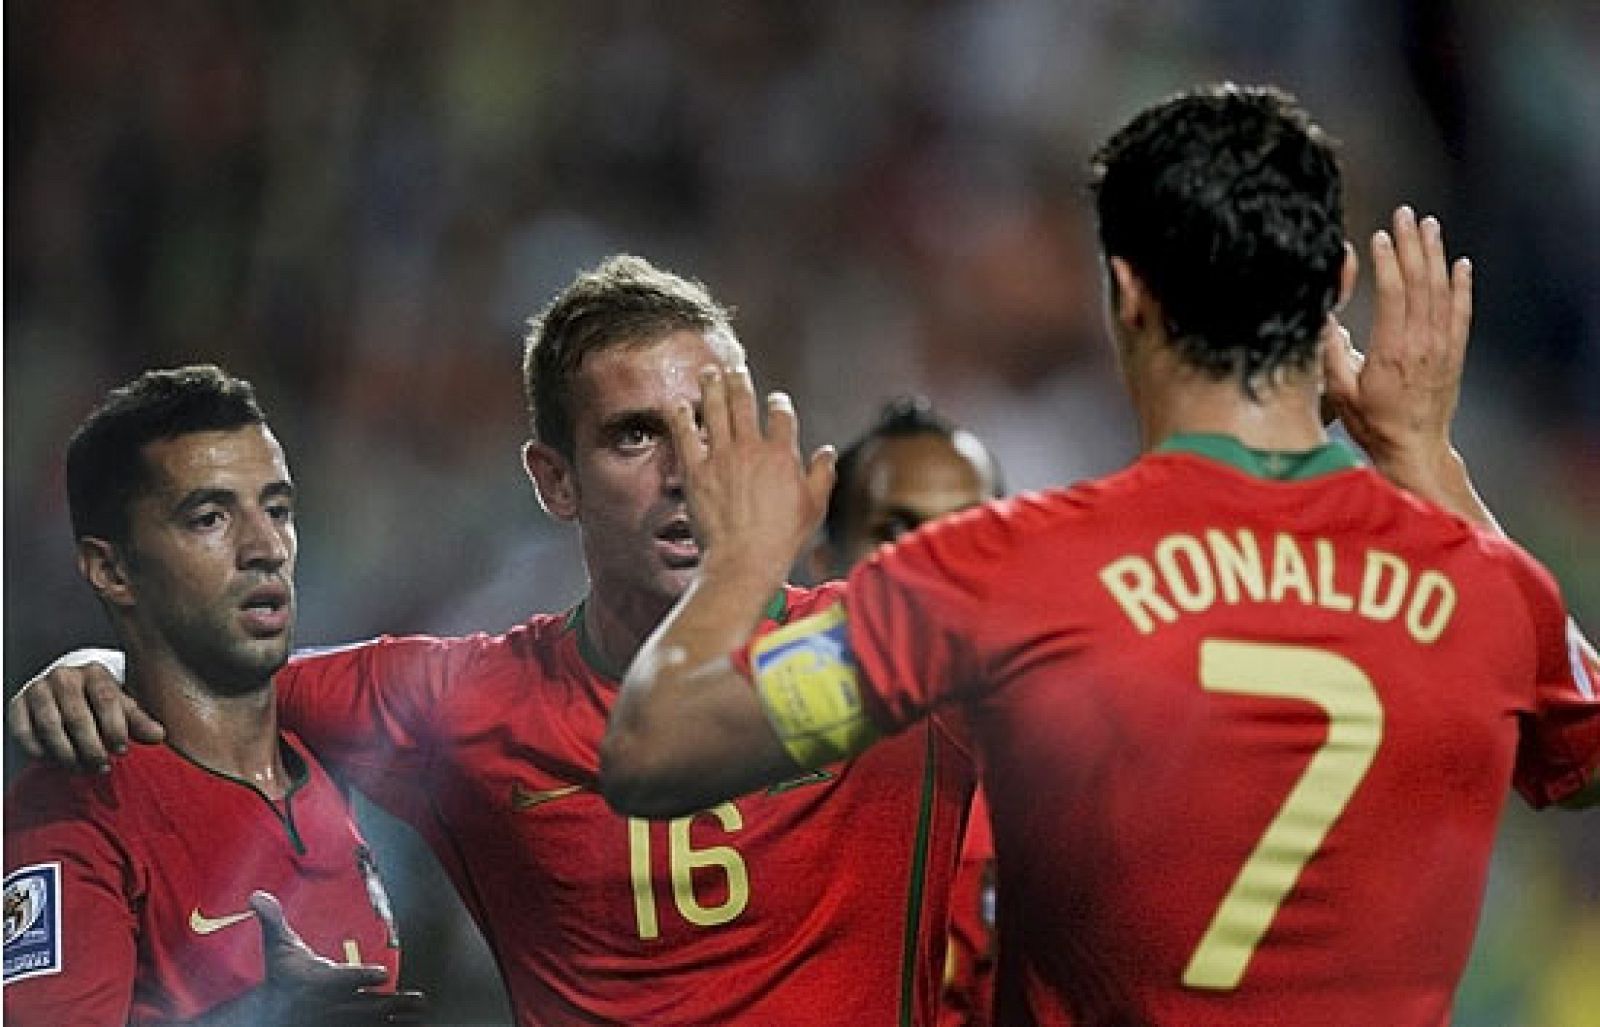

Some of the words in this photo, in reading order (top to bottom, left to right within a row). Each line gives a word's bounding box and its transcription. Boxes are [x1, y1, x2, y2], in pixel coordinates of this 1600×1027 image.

[1099, 528, 1457, 643] RONALDO
[629, 802, 749, 940] 16
[1181, 638, 1384, 988] 7
